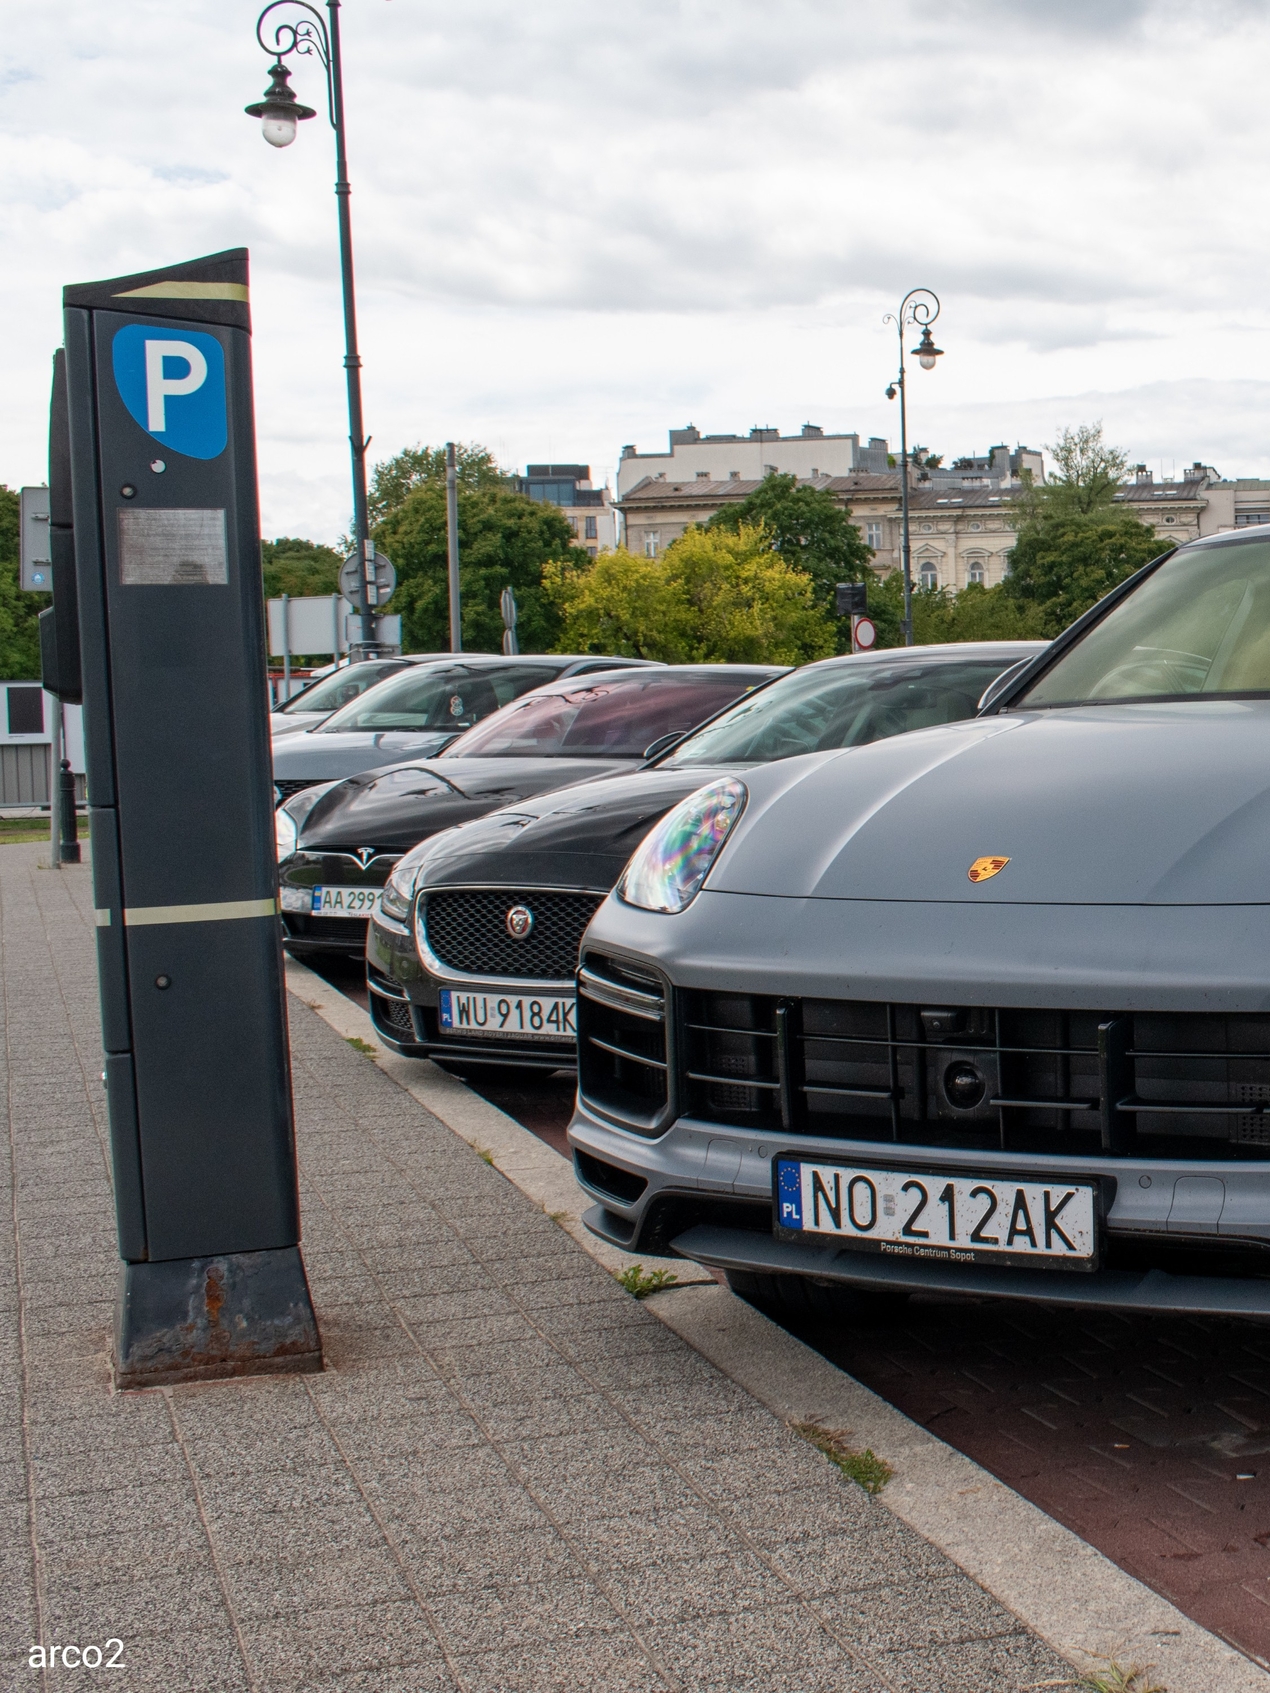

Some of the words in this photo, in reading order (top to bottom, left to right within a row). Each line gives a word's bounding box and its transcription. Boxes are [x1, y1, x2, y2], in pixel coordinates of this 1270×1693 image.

[145, 340, 207, 432] P
[442, 1013, 452, 1022] PL
[782, 1202, 800, 1219] PL
[880, 1242, 913, 1255] Porsche
[913, 1246, 949, 1259] Centrum
[950, 1249, 976, 1262] Sopot
